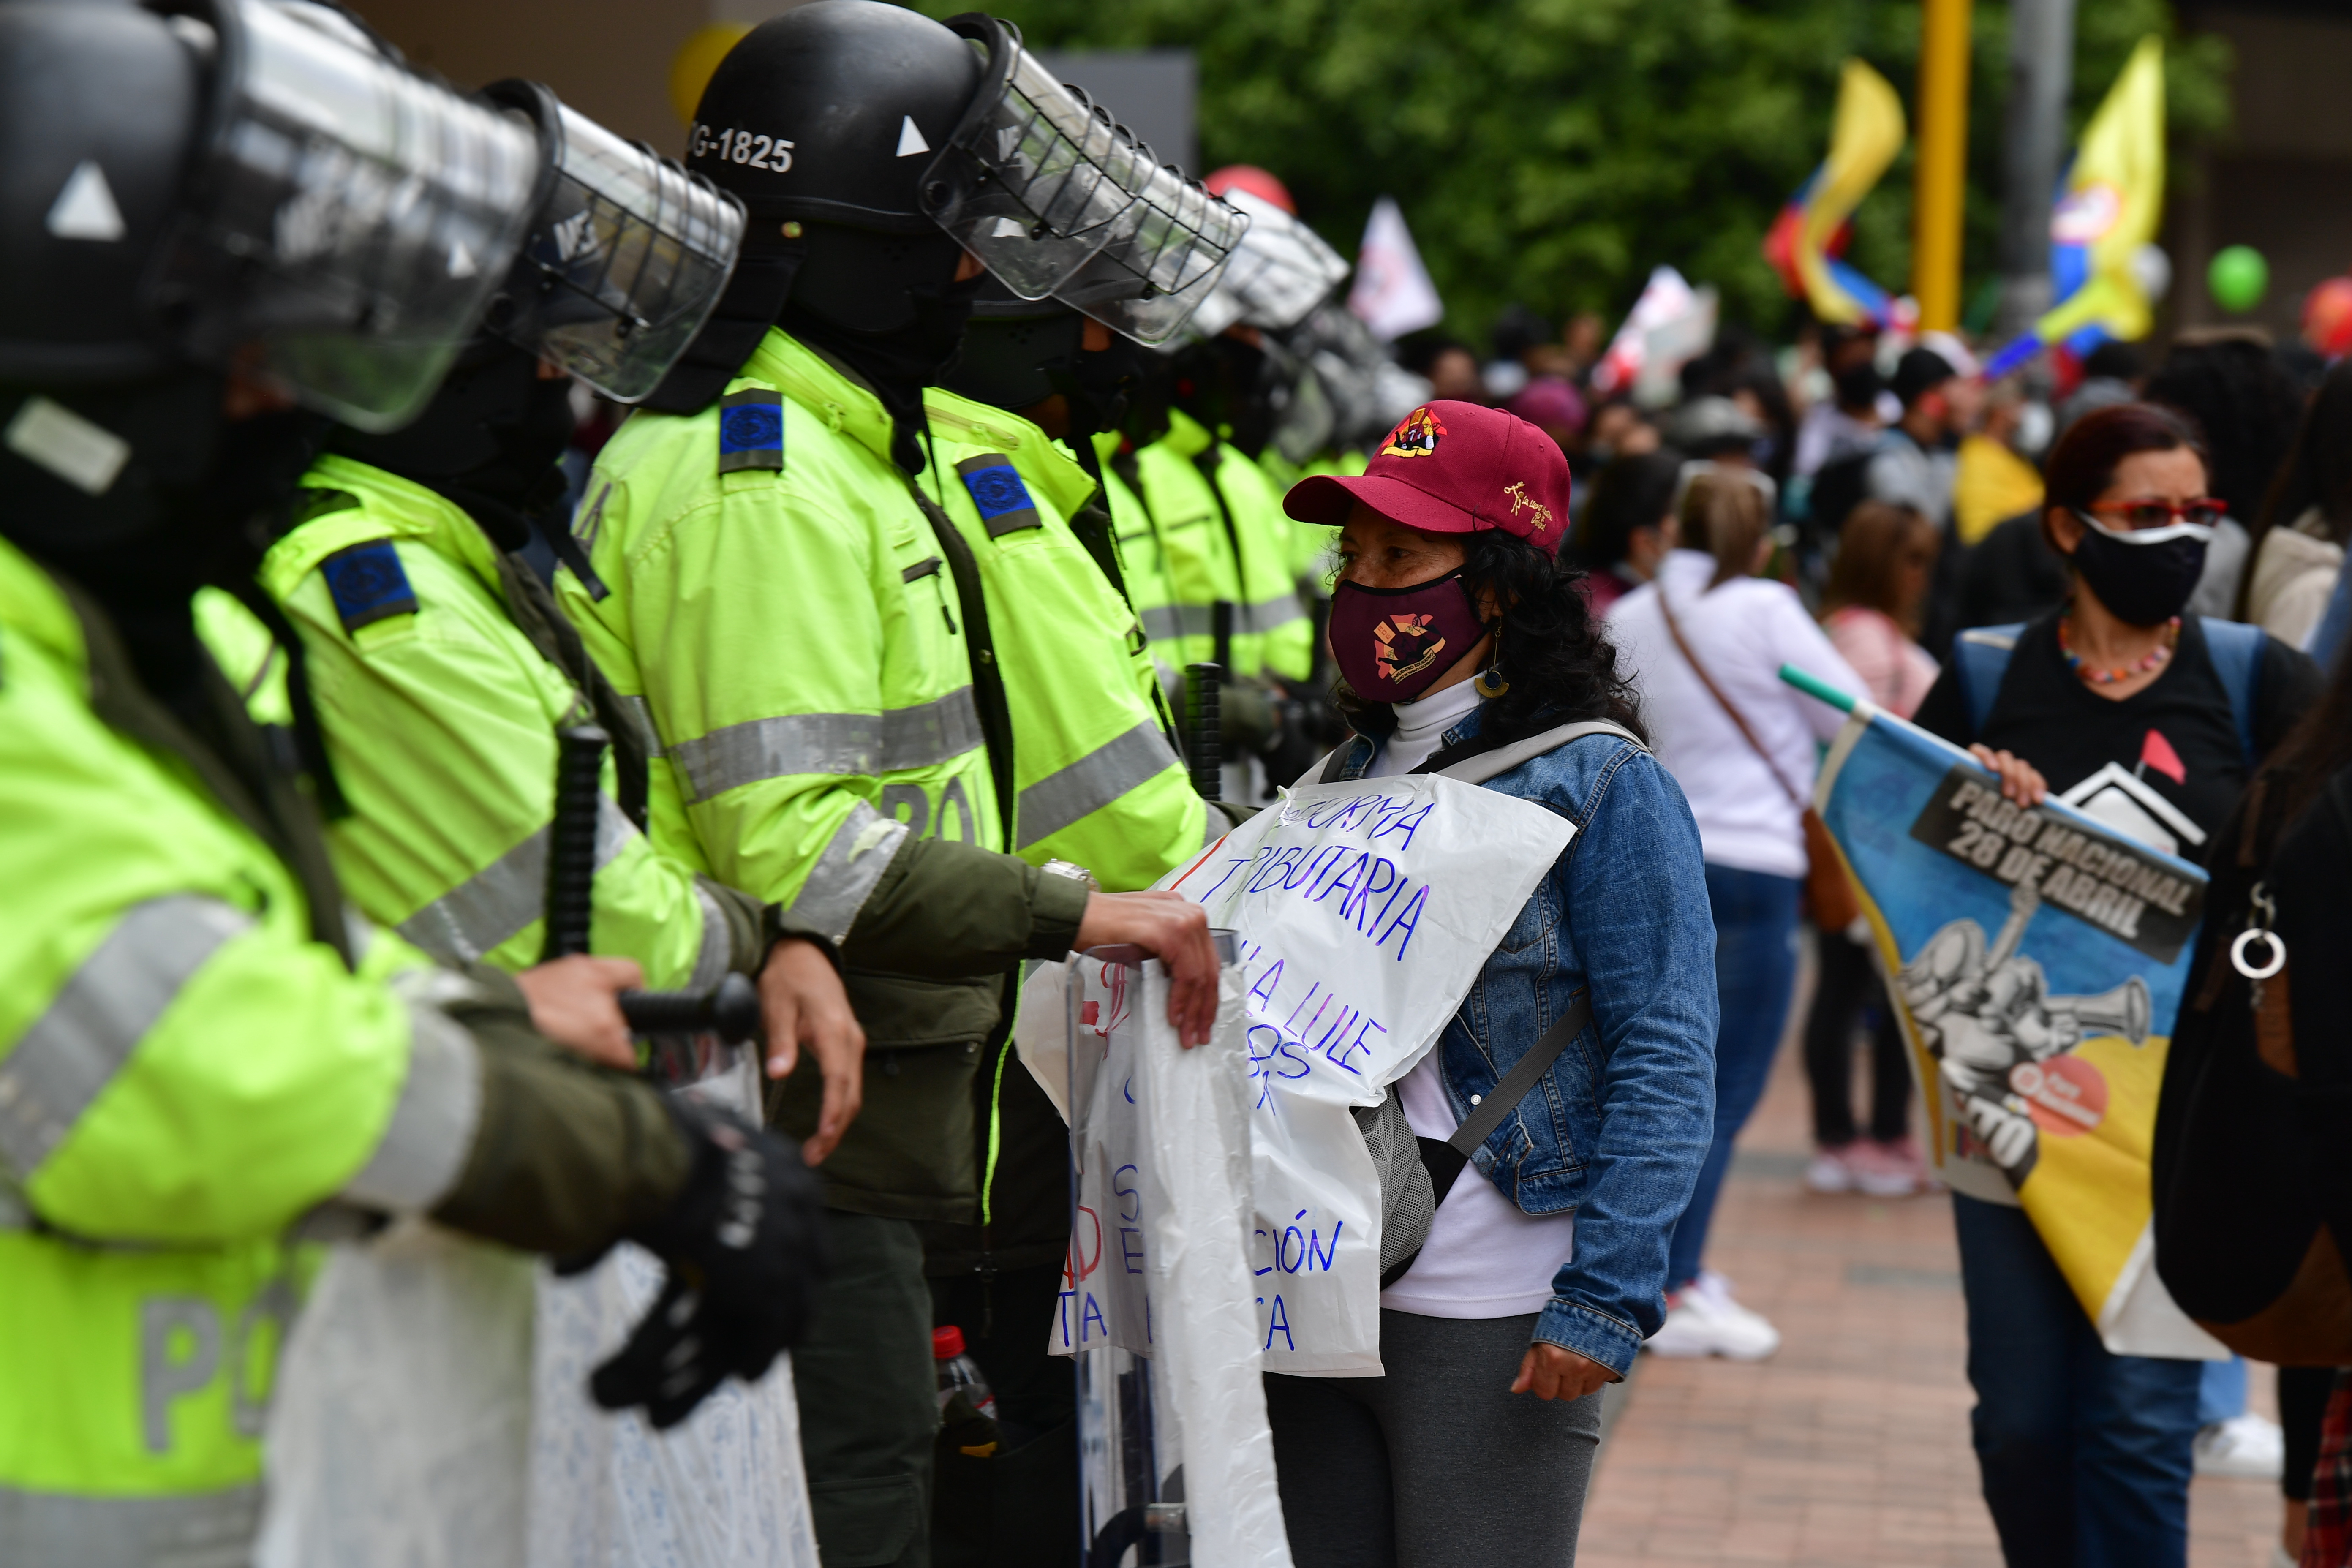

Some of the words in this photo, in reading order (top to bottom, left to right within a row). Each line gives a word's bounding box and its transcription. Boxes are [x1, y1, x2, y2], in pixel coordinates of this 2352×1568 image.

[688, 120, 795, 173] G-1825
[1199, 845, 1430, 962] TRIBUTARIA
[1947, 821, 2006, 869] 28
[1996, 844, 2054, 885] DE
[2039, 865, 2146, 939] ABRIL
[1948, 779, 2044, 844] PARO
[2034, 821, 2192, 917] NACIONAL
[1283, 981, 1387, 1076] LULE
